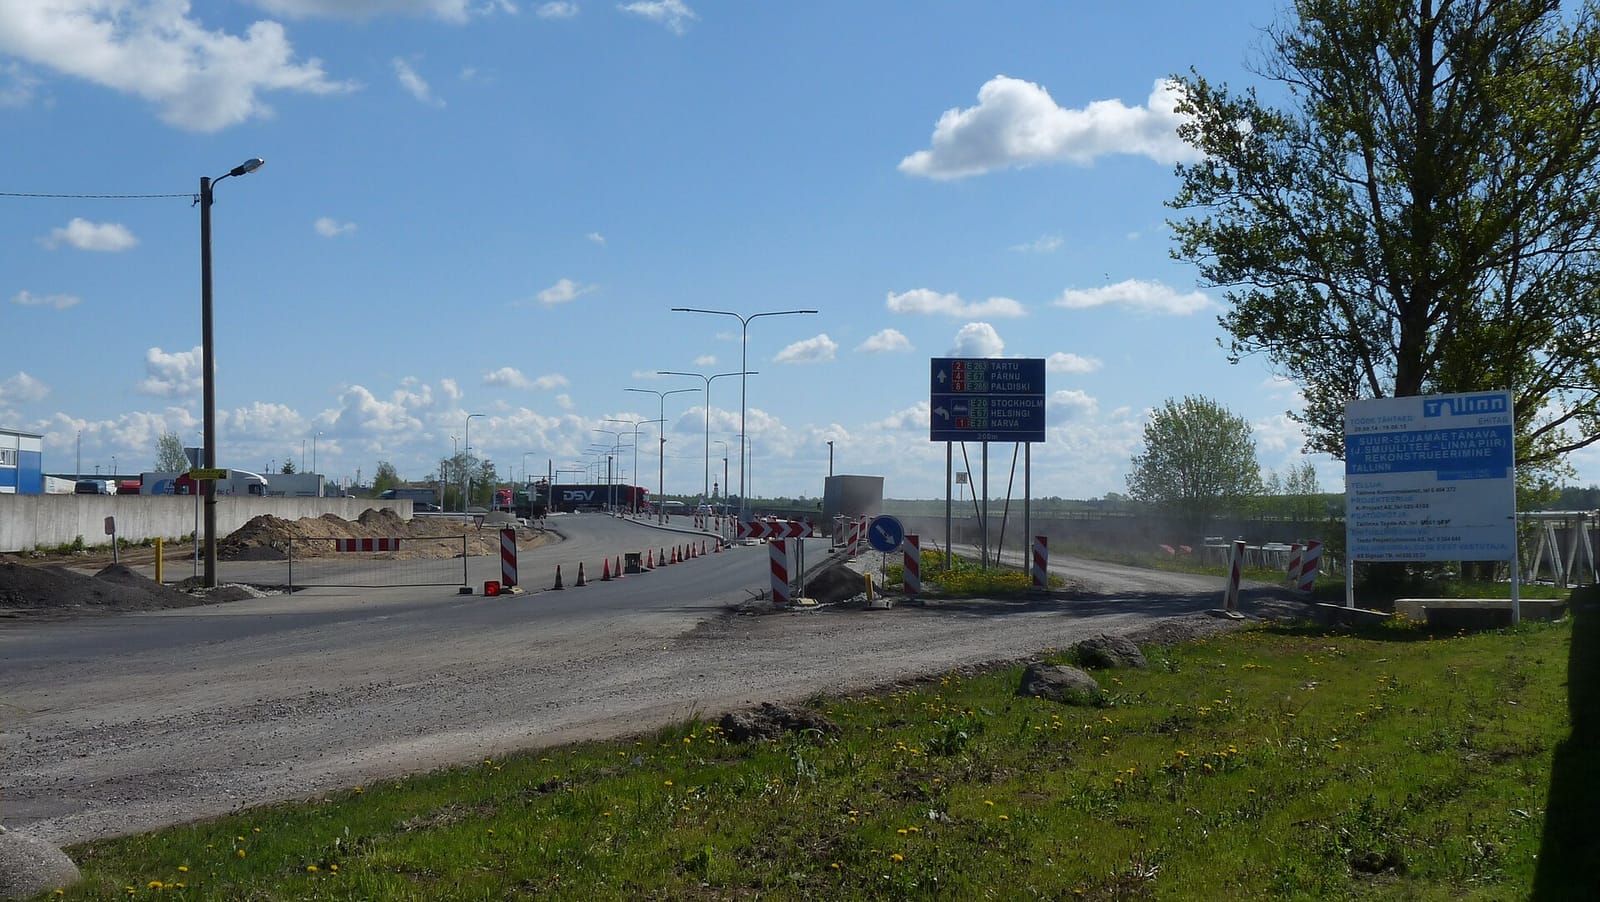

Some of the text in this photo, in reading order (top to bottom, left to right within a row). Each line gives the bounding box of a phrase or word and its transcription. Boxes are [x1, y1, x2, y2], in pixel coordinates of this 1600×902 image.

[991, 362, 1019, 370] TARTU
[991, 383, 1031, 391] PALDISKI
[991, 400, 1043, 408] STOCKHOLM
[991, 409, 1030, 417] HELSINGI
[991, 419, 1019, 427] NARVA
[1408, 441, 1431, 452] TEE
[1441, 439, 1476, 451] LINNA
[1479, 438, 1506, 449] PIIR)
[1365, 448, 1492, 463] REKONSTRUEERIMINE
[1352, 463, 1392, 473] TALLINN
[563, 490, 595, 501] DSV
